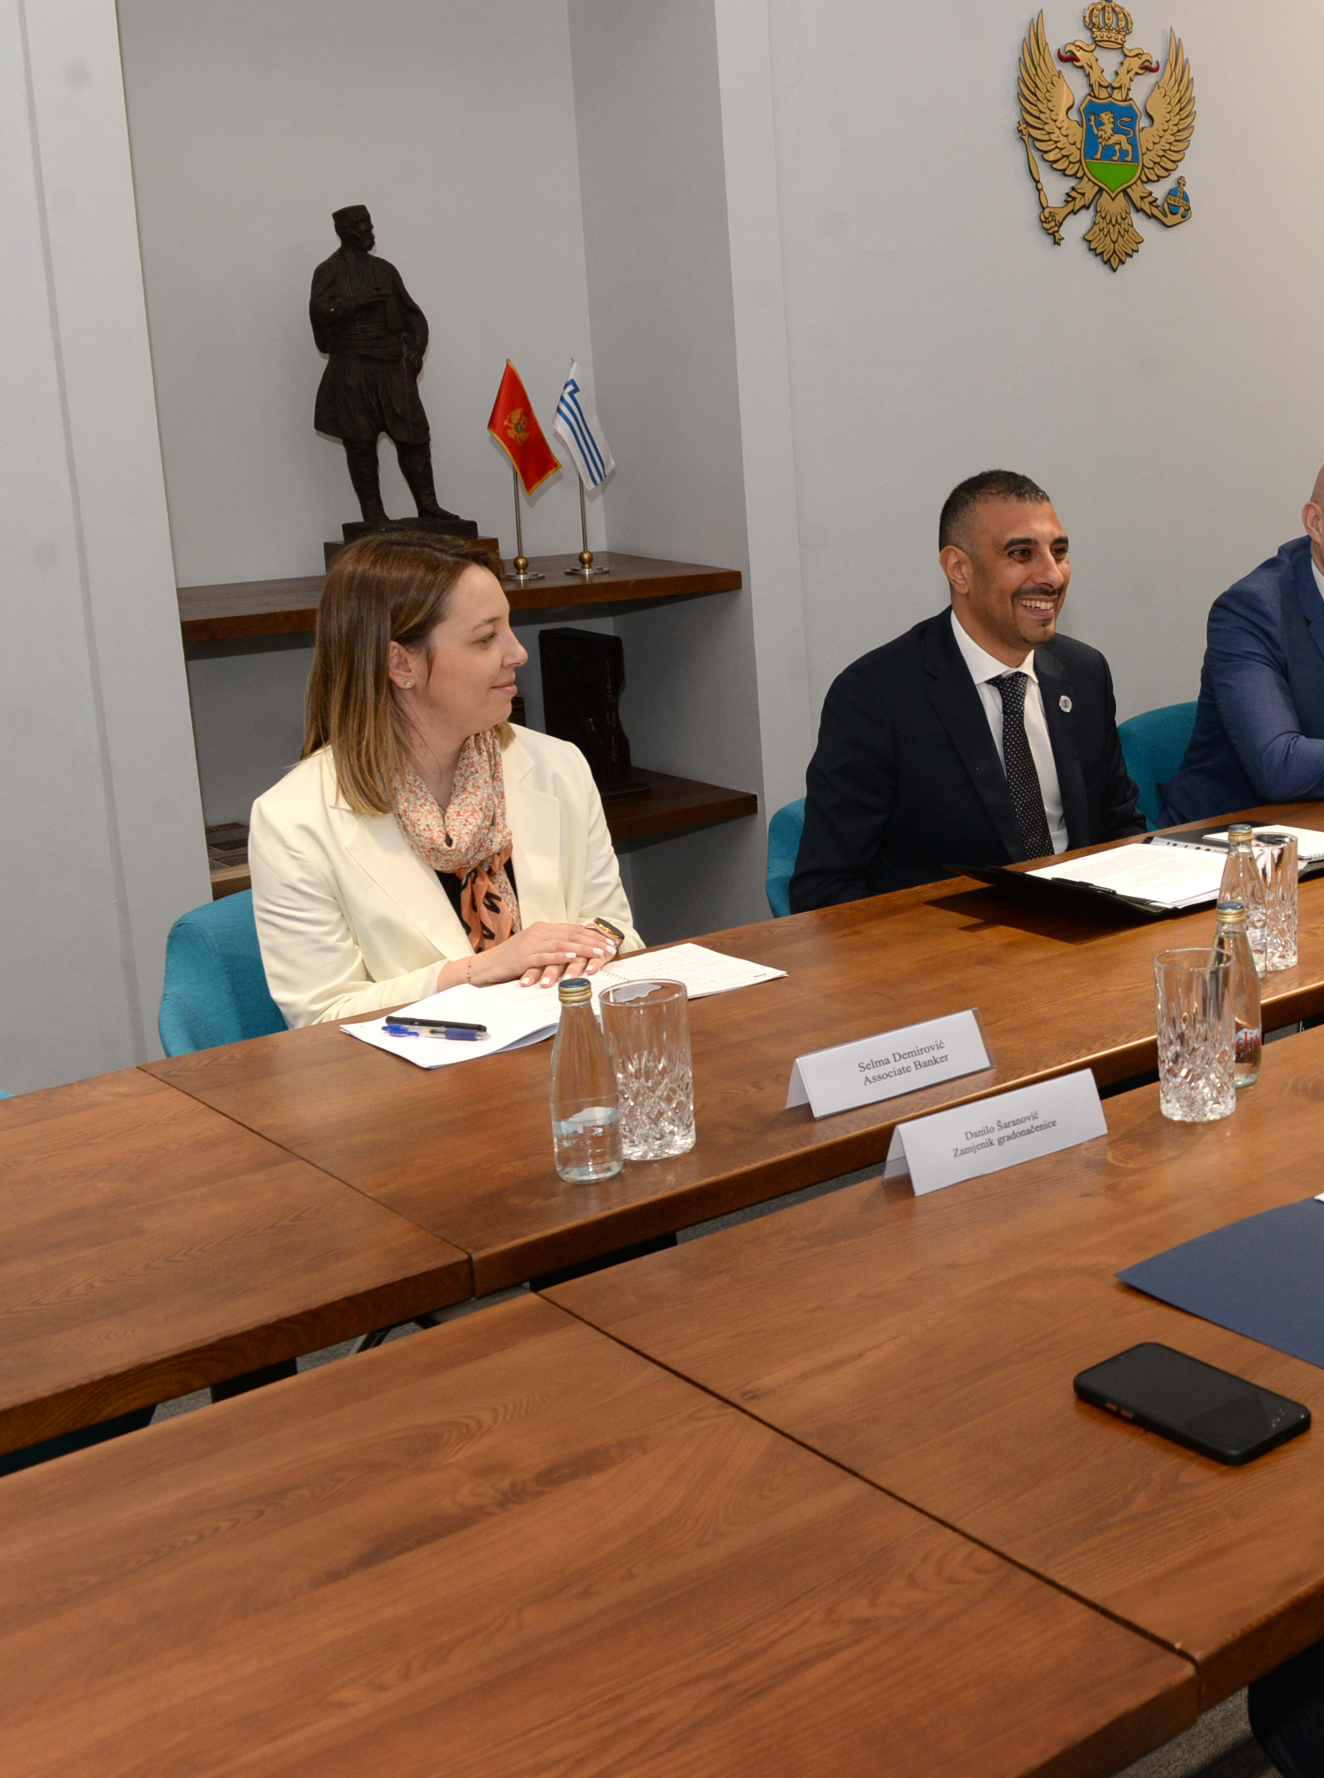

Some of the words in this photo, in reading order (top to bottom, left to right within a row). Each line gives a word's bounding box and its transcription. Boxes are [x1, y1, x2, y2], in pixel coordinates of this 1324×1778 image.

[857, 1057, 890, 1072] Selma
[892, 1040, 945, 1062] Demirović
[863, 1065, 911, 1085] Associate
[913, 1054, 949, 1071] Banker
[964, 1125, 995, 1141] Danilo
[996, 1110, 1040, 1131] Šaranović
[952, 1138, 995, 1158] Zamjenik
